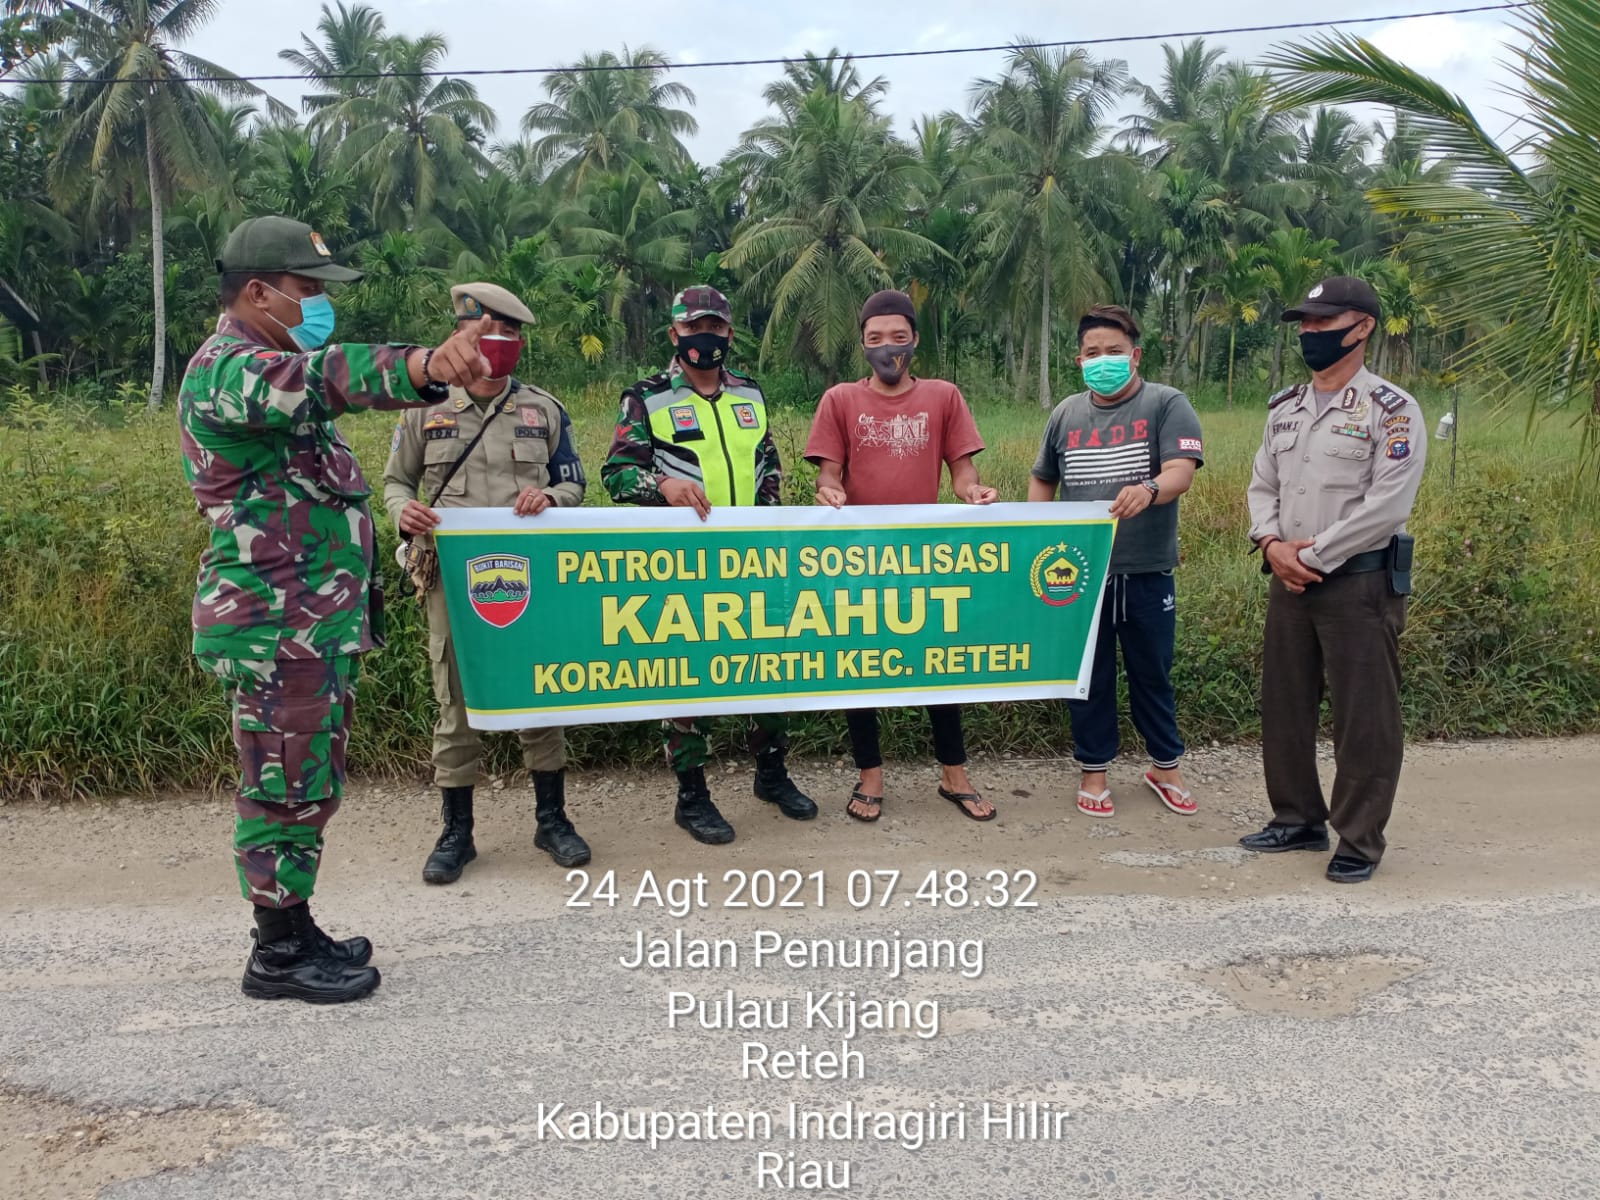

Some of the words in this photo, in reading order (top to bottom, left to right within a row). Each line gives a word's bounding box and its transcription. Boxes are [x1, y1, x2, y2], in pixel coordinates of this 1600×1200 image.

[557, 548, 708, 584] PATROLI
[718, 546, 788, 580] DAN
[798, 541, 1010, 578] SOSIALISASI
[601, 586, 972, 646] KARLAHUT
[533, 656, 700, 695] KORAMIL
[709, 650, 825, 685] 07/RTH
[836, 647, 914, 679] KEC.
[924, 642, 1031, 675] RETEH
